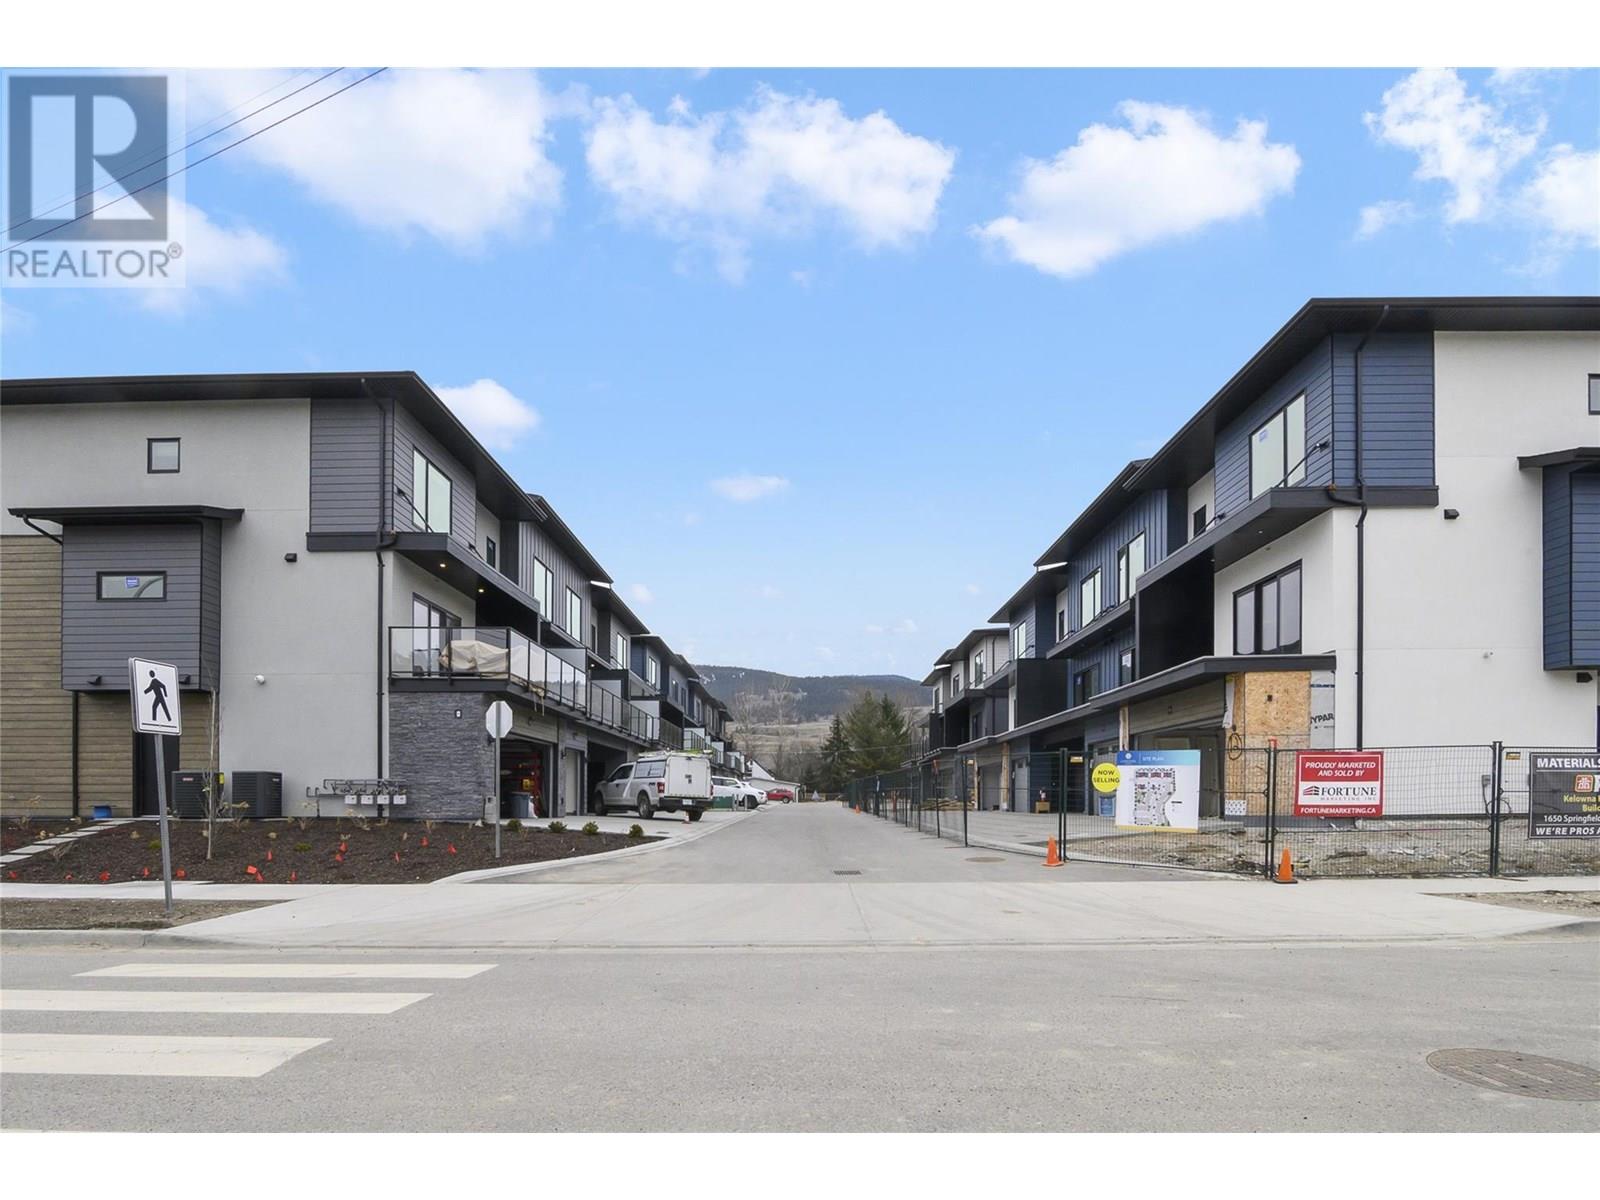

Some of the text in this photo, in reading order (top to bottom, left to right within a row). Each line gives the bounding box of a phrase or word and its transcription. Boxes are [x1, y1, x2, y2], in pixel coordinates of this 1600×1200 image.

[1321, 786, 1377, 796] FORTUNE
[1563, 794, 1596, 803] Kelowna
[1544, 814, 1562, 822] 1650
[1536, 827, 1568, 835] WE'RE
[1569, 827, 1595, 835] PROS
